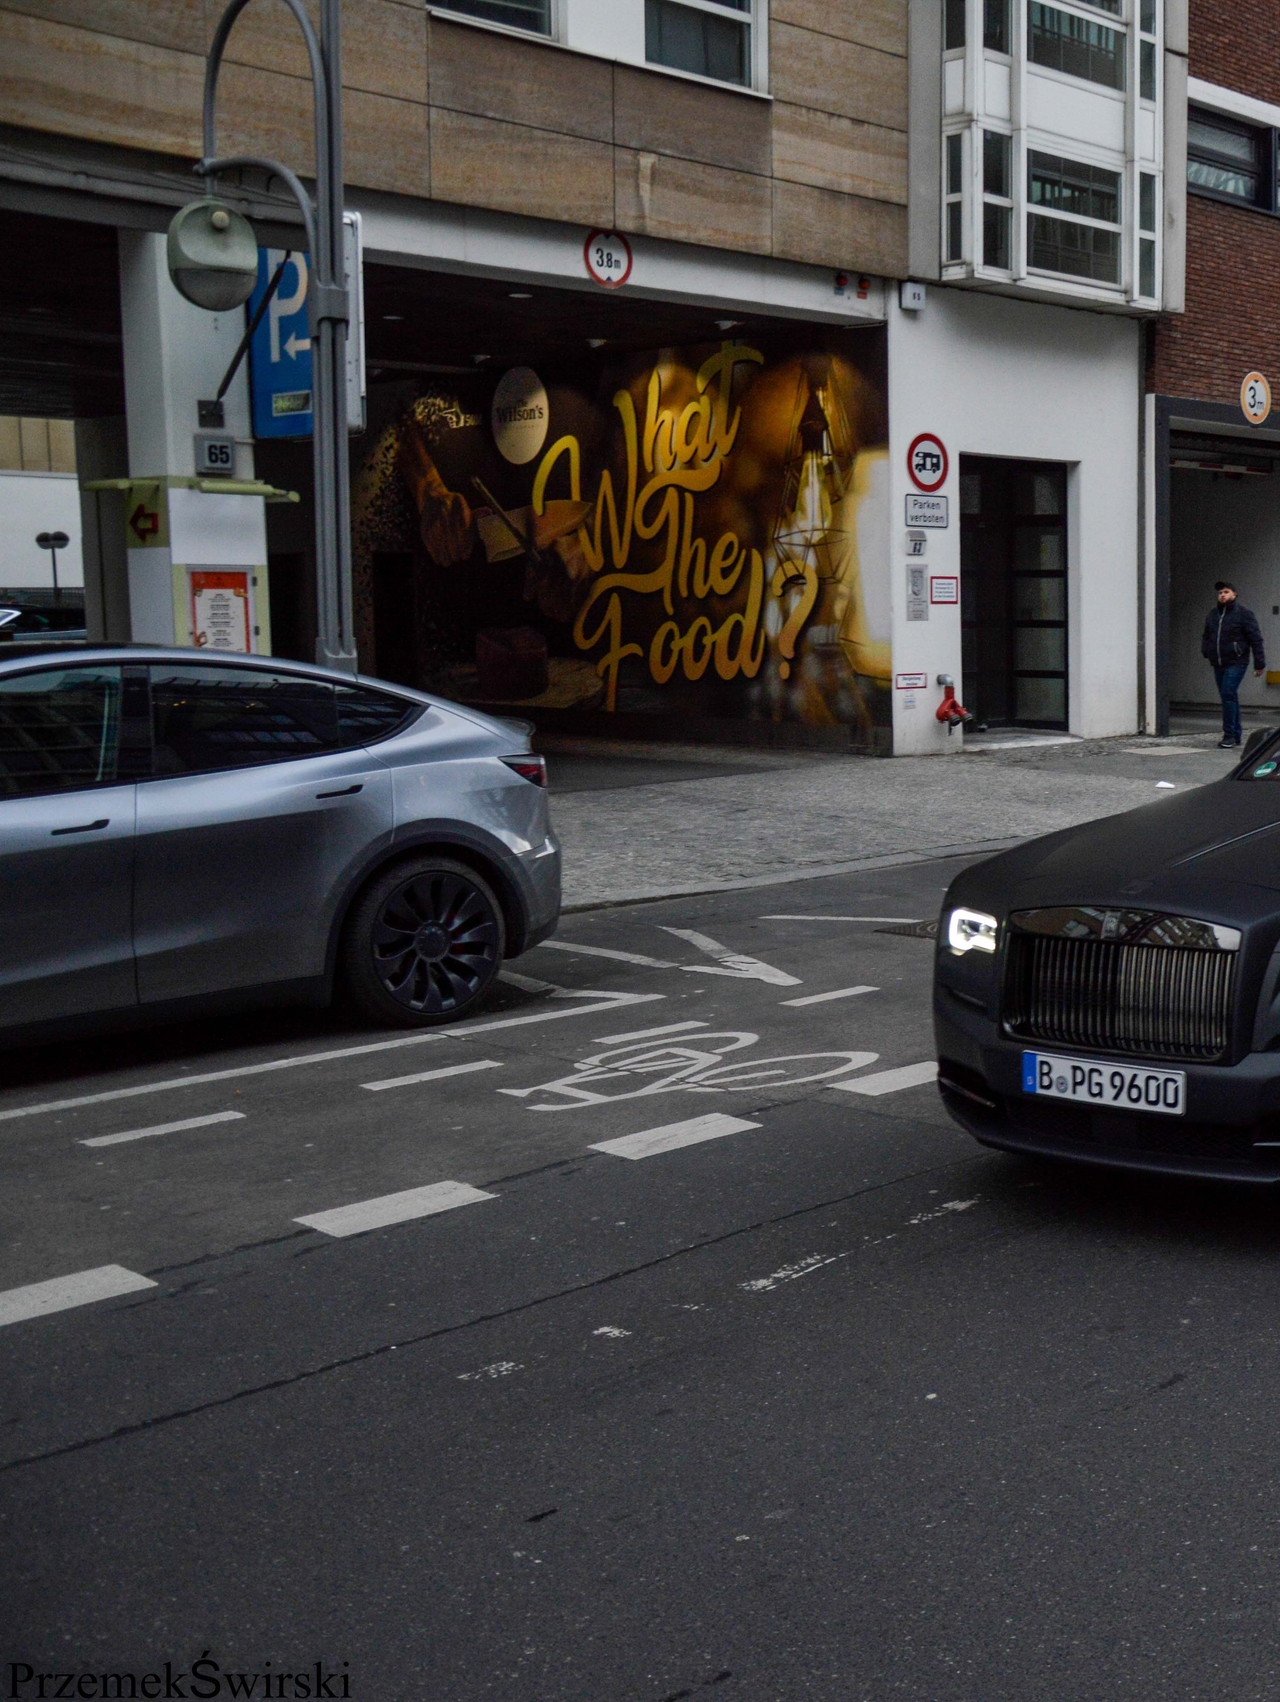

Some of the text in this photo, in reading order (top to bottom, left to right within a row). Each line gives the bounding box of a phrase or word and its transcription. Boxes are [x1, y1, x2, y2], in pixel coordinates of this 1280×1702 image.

[267, 248, 308, 363] P
[496, 405, 544, 422] Wilson's
[207, 444, 230, 464] 65
[532, 340, 764, 573] What
[908, 513, 945, 523] verboten
[913, 499, 941, 510] Parken
[633, 460, 747, 616] The
[573, 548, 819, 713] Food?
[1039, 1060, 1180, 1108] B PG 9600
